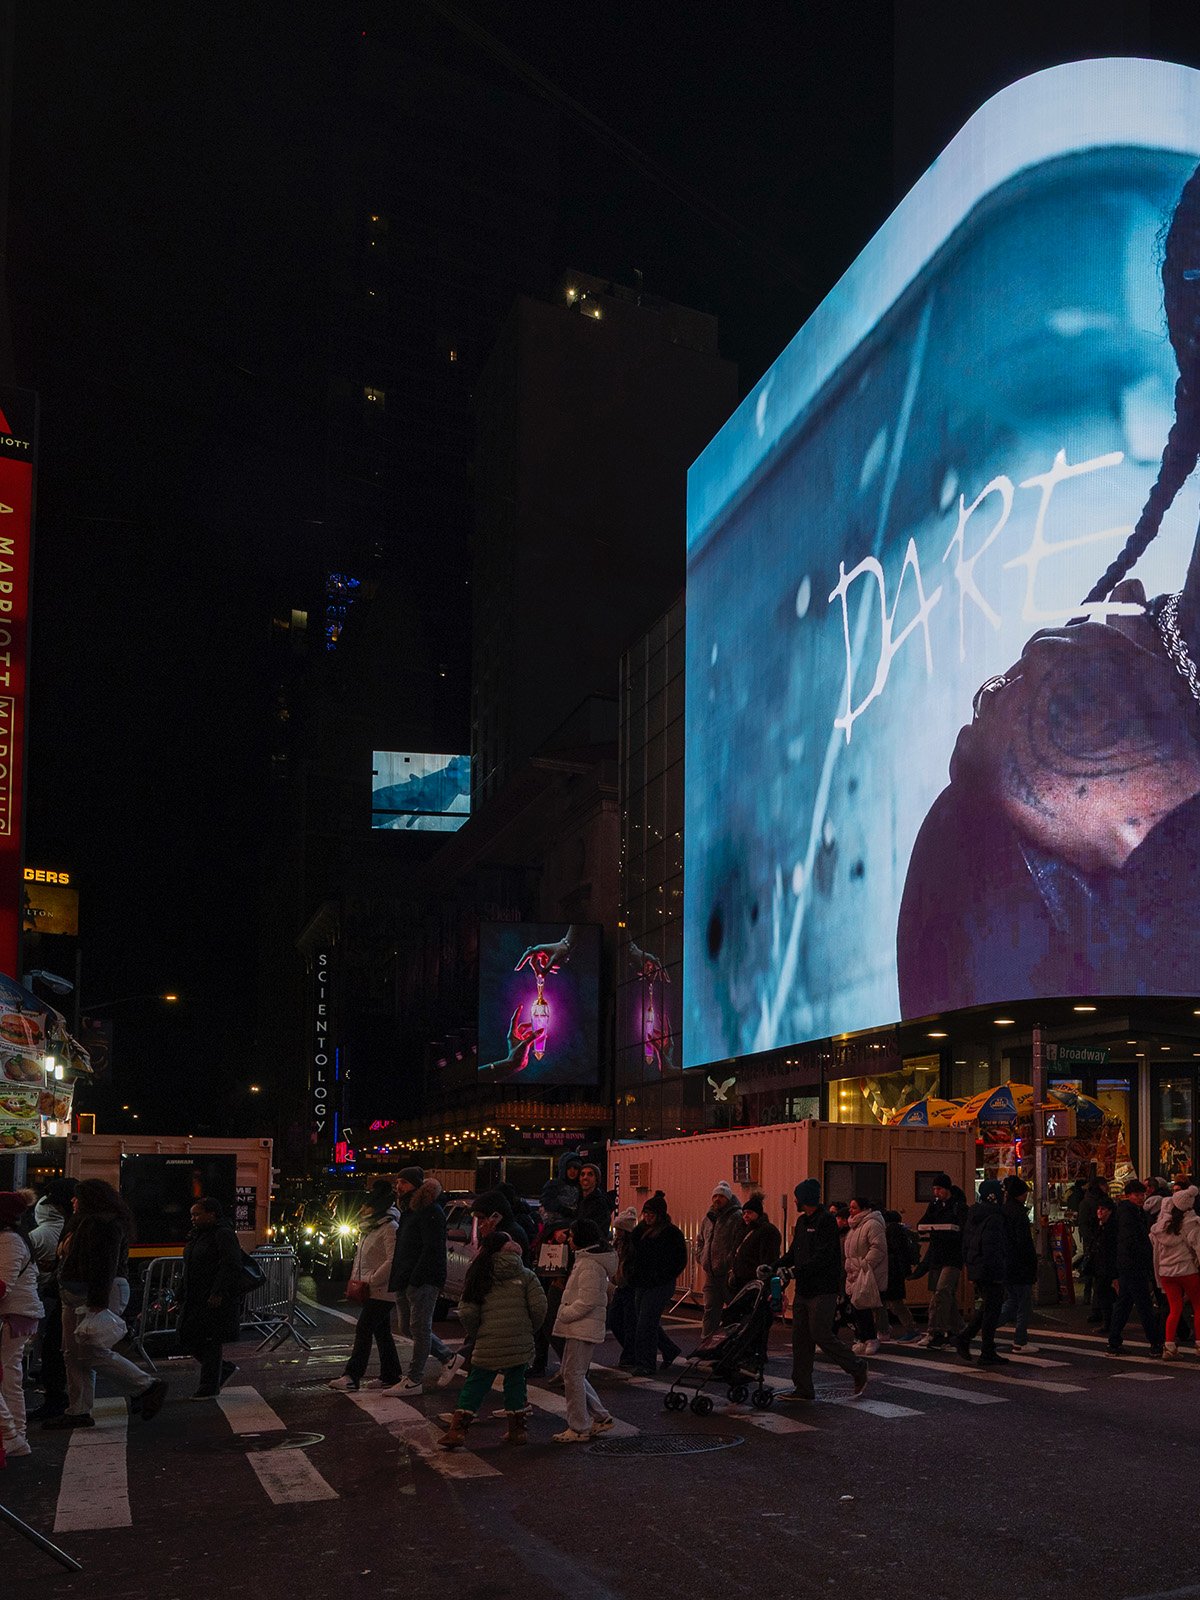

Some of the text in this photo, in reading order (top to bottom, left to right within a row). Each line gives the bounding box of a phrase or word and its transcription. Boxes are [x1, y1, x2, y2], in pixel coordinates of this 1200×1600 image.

[827, 448, 1145, 744] DARE
[24, 868, 70, 885] GERS
[314, 954, 328, 1132] SCIENTOLOGY
[1060, 1047, 1106, 1064] Broadway
